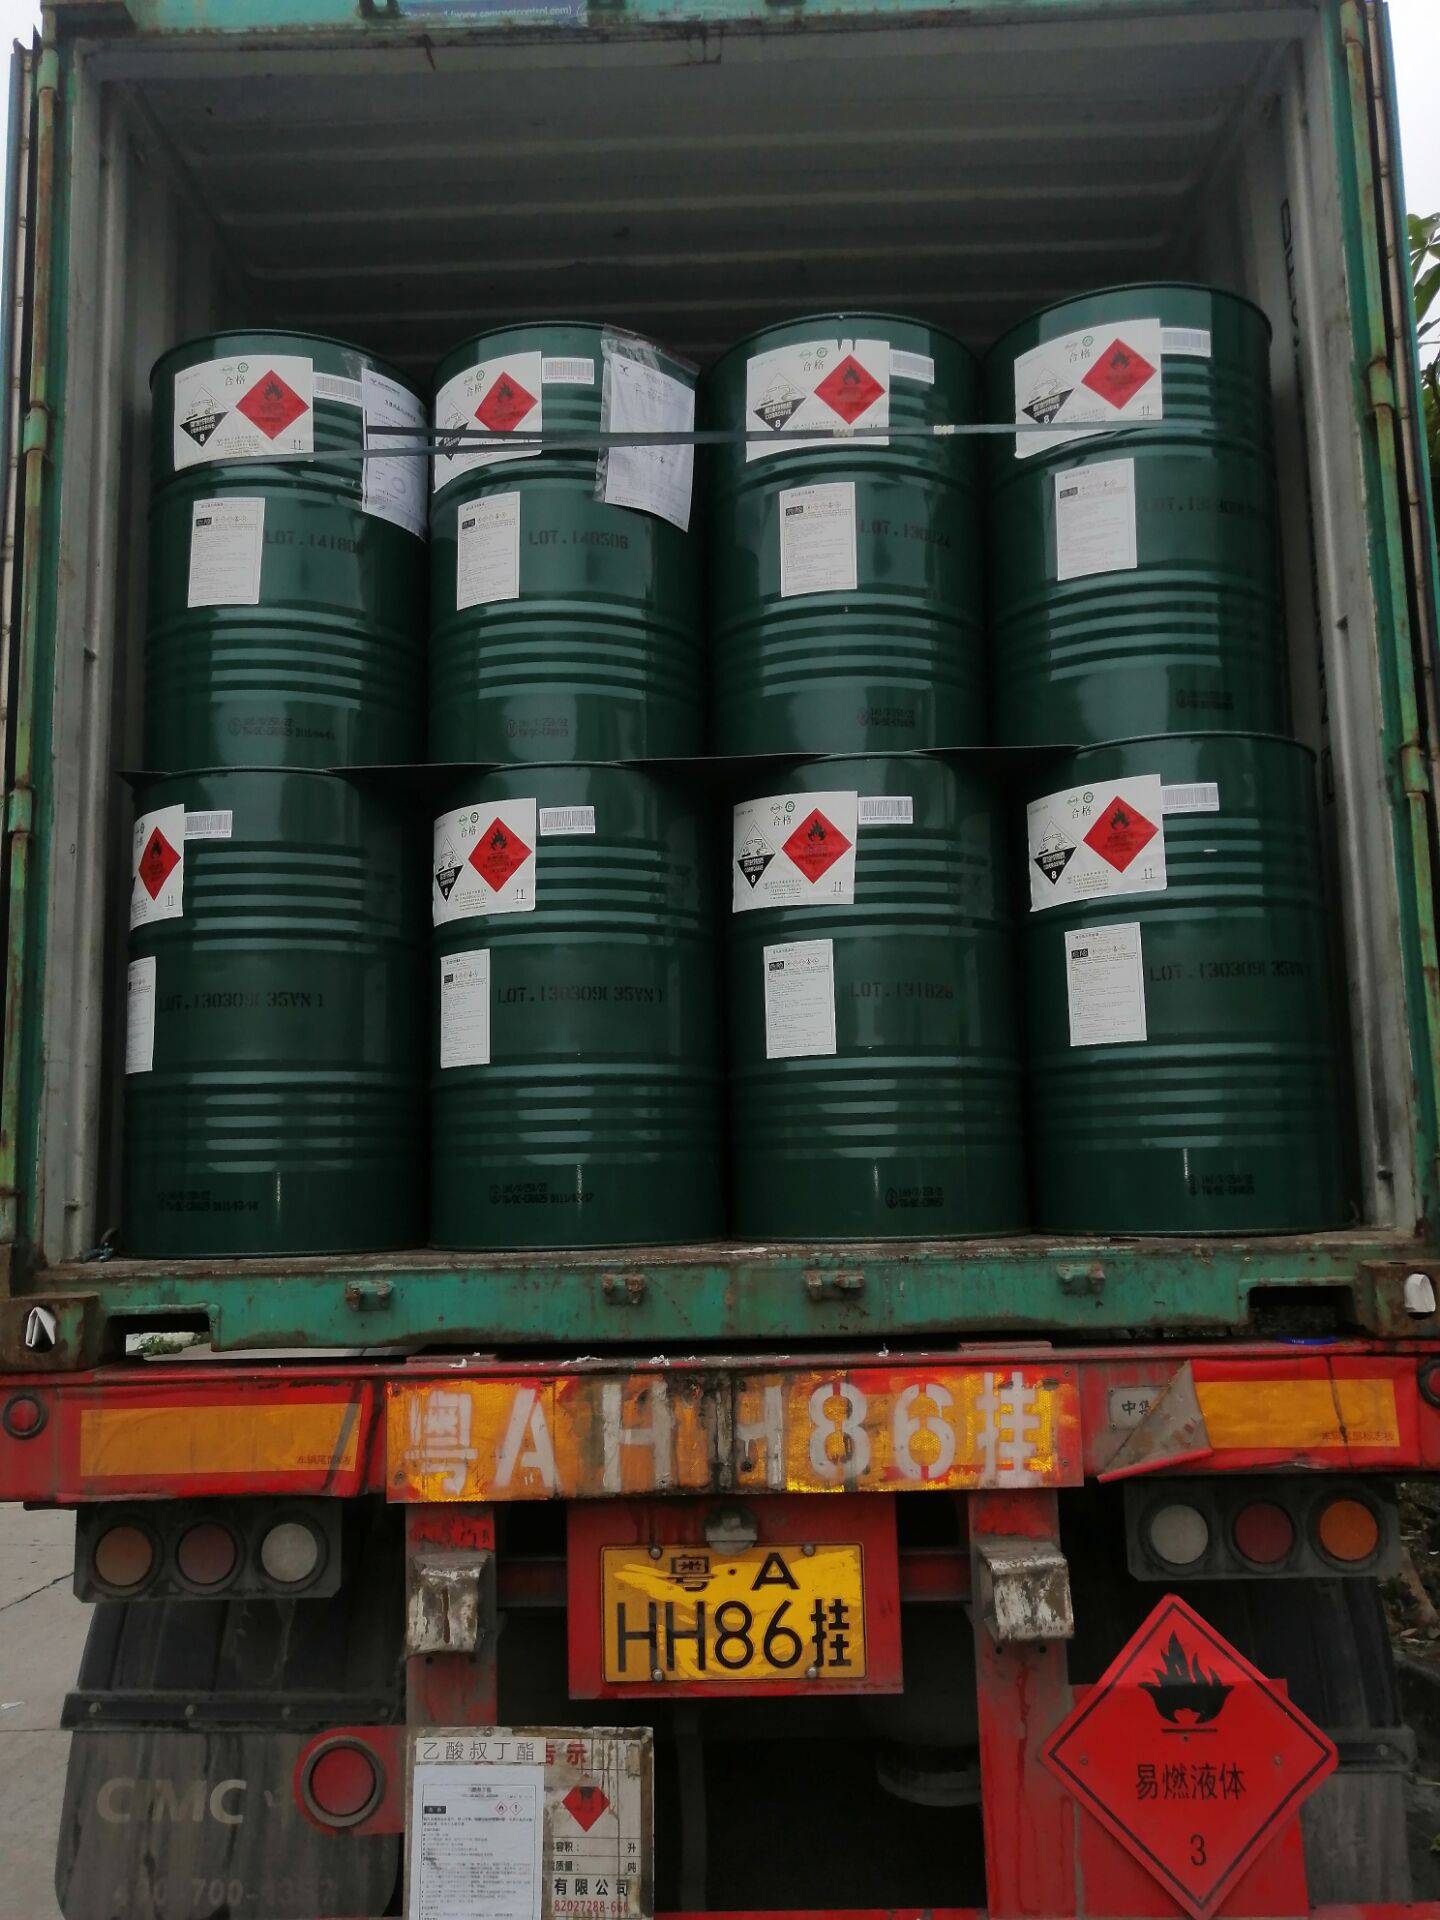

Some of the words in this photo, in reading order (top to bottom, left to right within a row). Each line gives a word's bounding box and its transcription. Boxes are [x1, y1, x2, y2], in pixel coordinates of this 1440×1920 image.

[616, 1598, 852, 1671] HH86挂
[423, 1741, 535, 1761] 乙酸叔丁酯
[1135, 1764, 1247, 1800] 易燃液体
[97, 1777, 247, 1824] CMC
[551, 1841, 580, 1853] 容积：
[627, 1842, 637, 1854] 升
[1189, 1833, 1207, 1866] 3
[551, 1860, 580, 1873] 质量：
[627, 1862, 637, 1874] 吨
[554, 1877, 628, 1897] 有限公司
